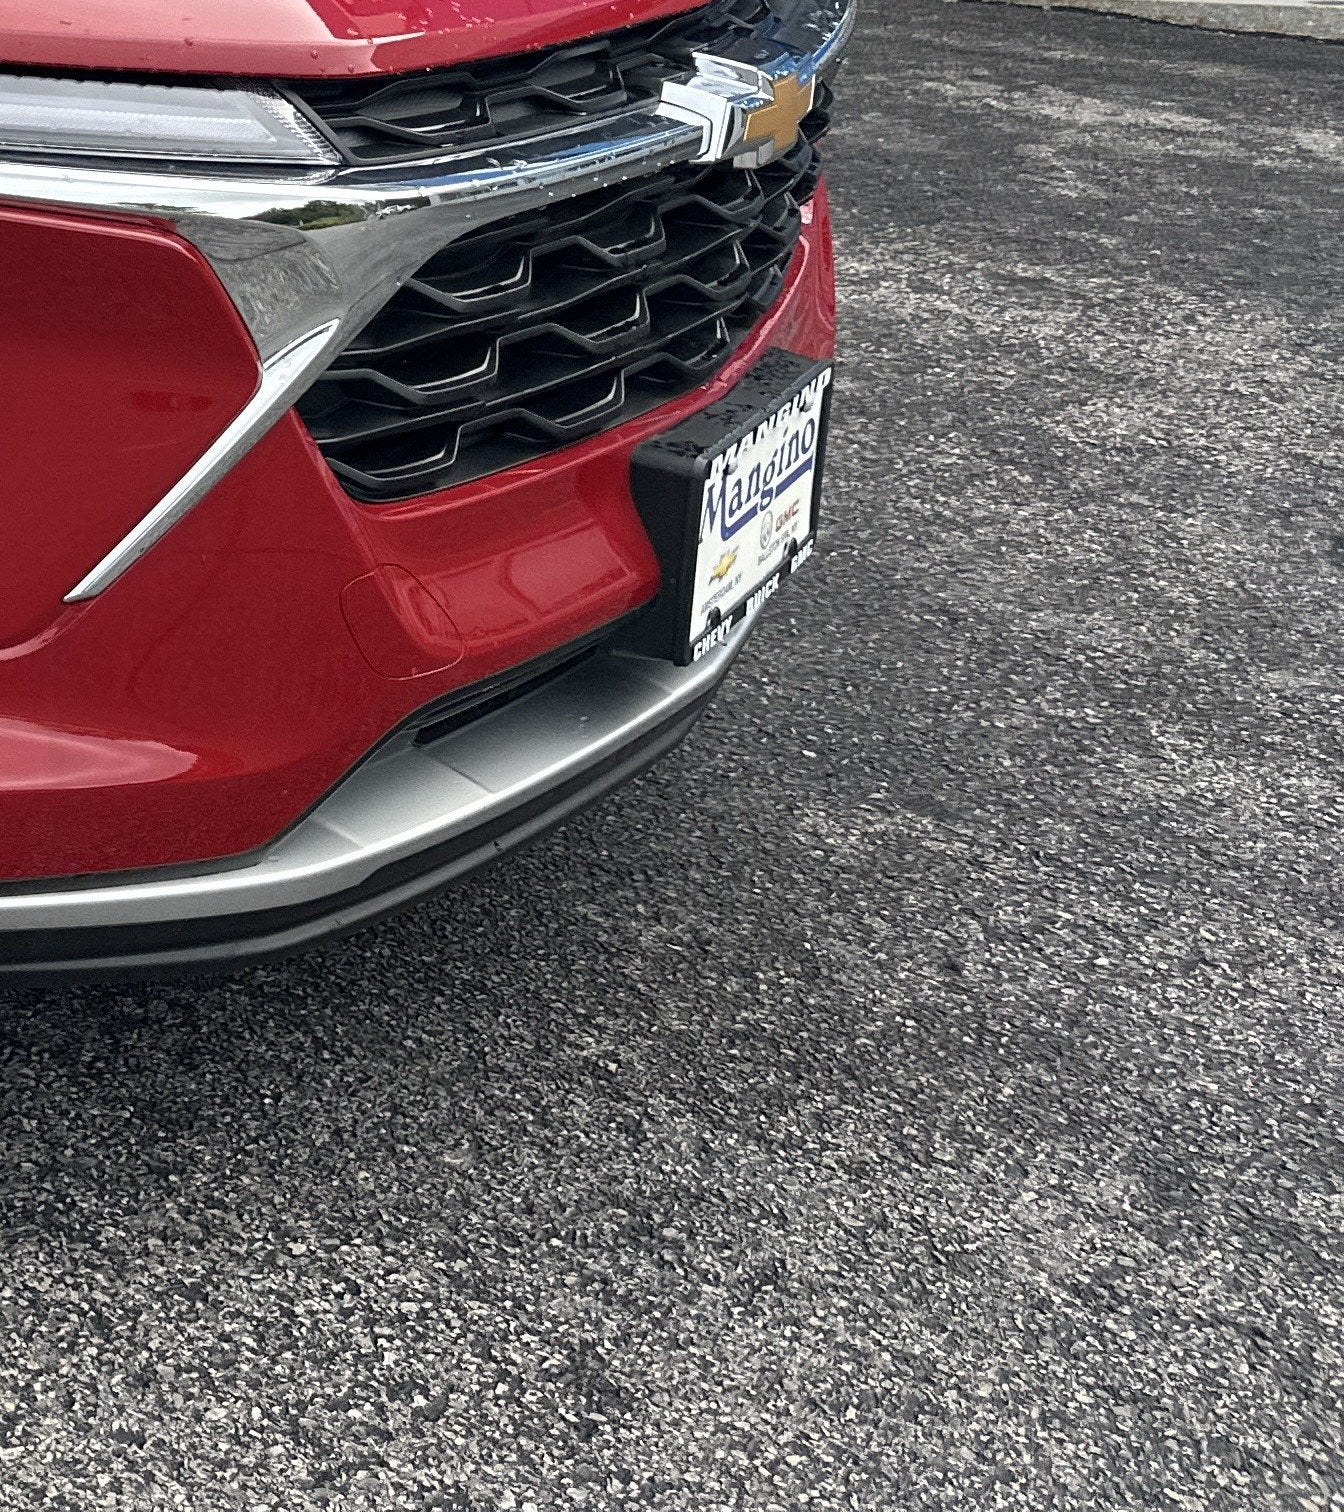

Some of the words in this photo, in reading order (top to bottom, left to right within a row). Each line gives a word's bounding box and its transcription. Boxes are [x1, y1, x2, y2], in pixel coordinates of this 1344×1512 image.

[709, 367, 832, 480] MANGINO
[698, 417, 816, 544] Mangino
[693, 614, 733, 662] CHEVY
[745, 572, 781, 618] BUICK
